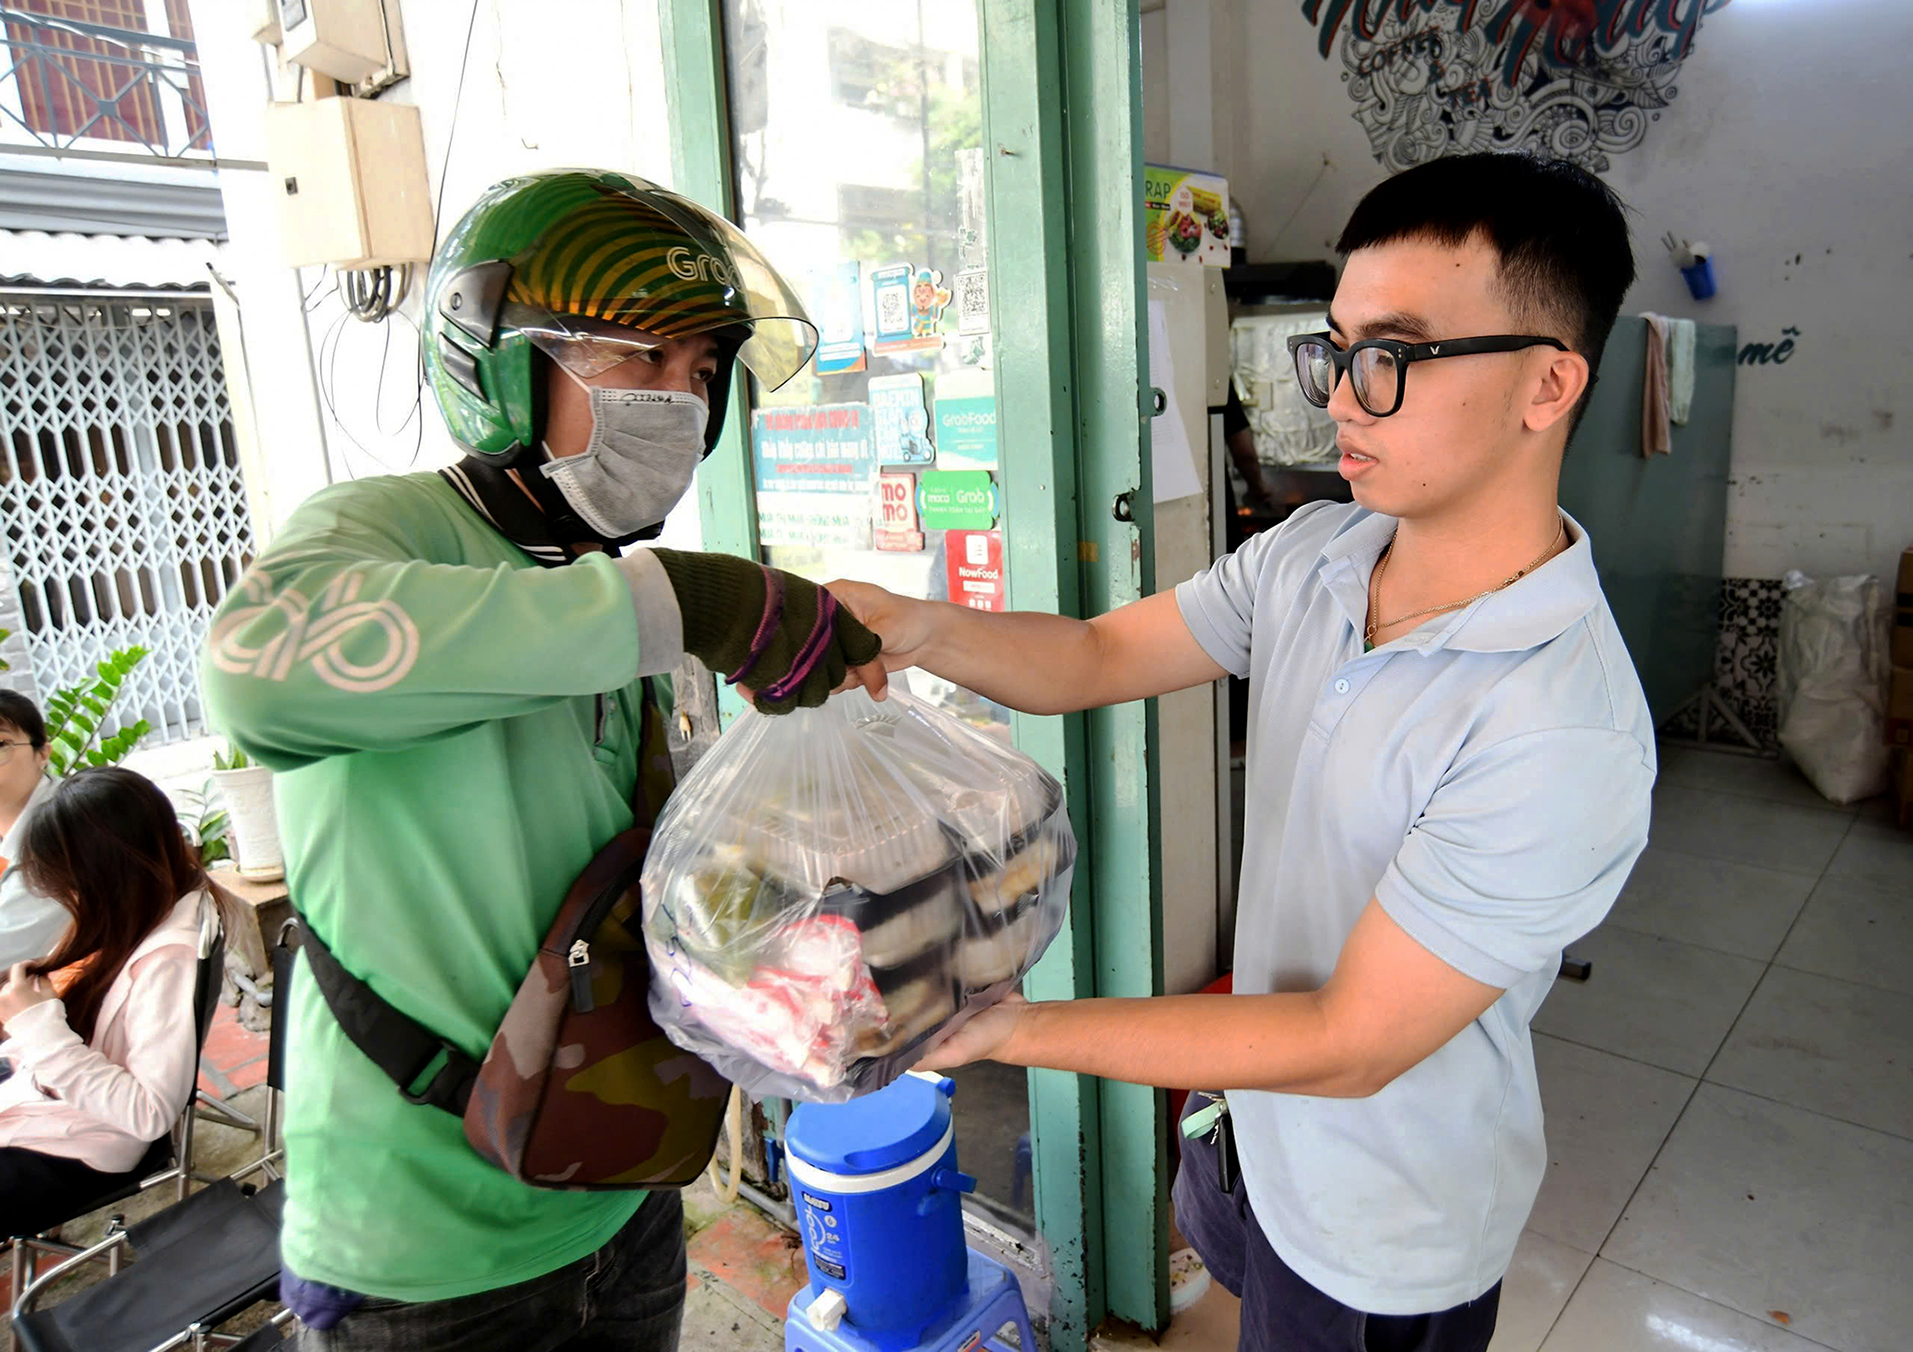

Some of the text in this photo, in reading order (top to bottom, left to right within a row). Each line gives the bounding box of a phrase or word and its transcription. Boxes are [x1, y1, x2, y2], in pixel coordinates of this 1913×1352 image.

[943, 409, 996, 428] GrabFood
[956, 487, 985, 504] Grab
[958, 566, 998, 580] NowFood
